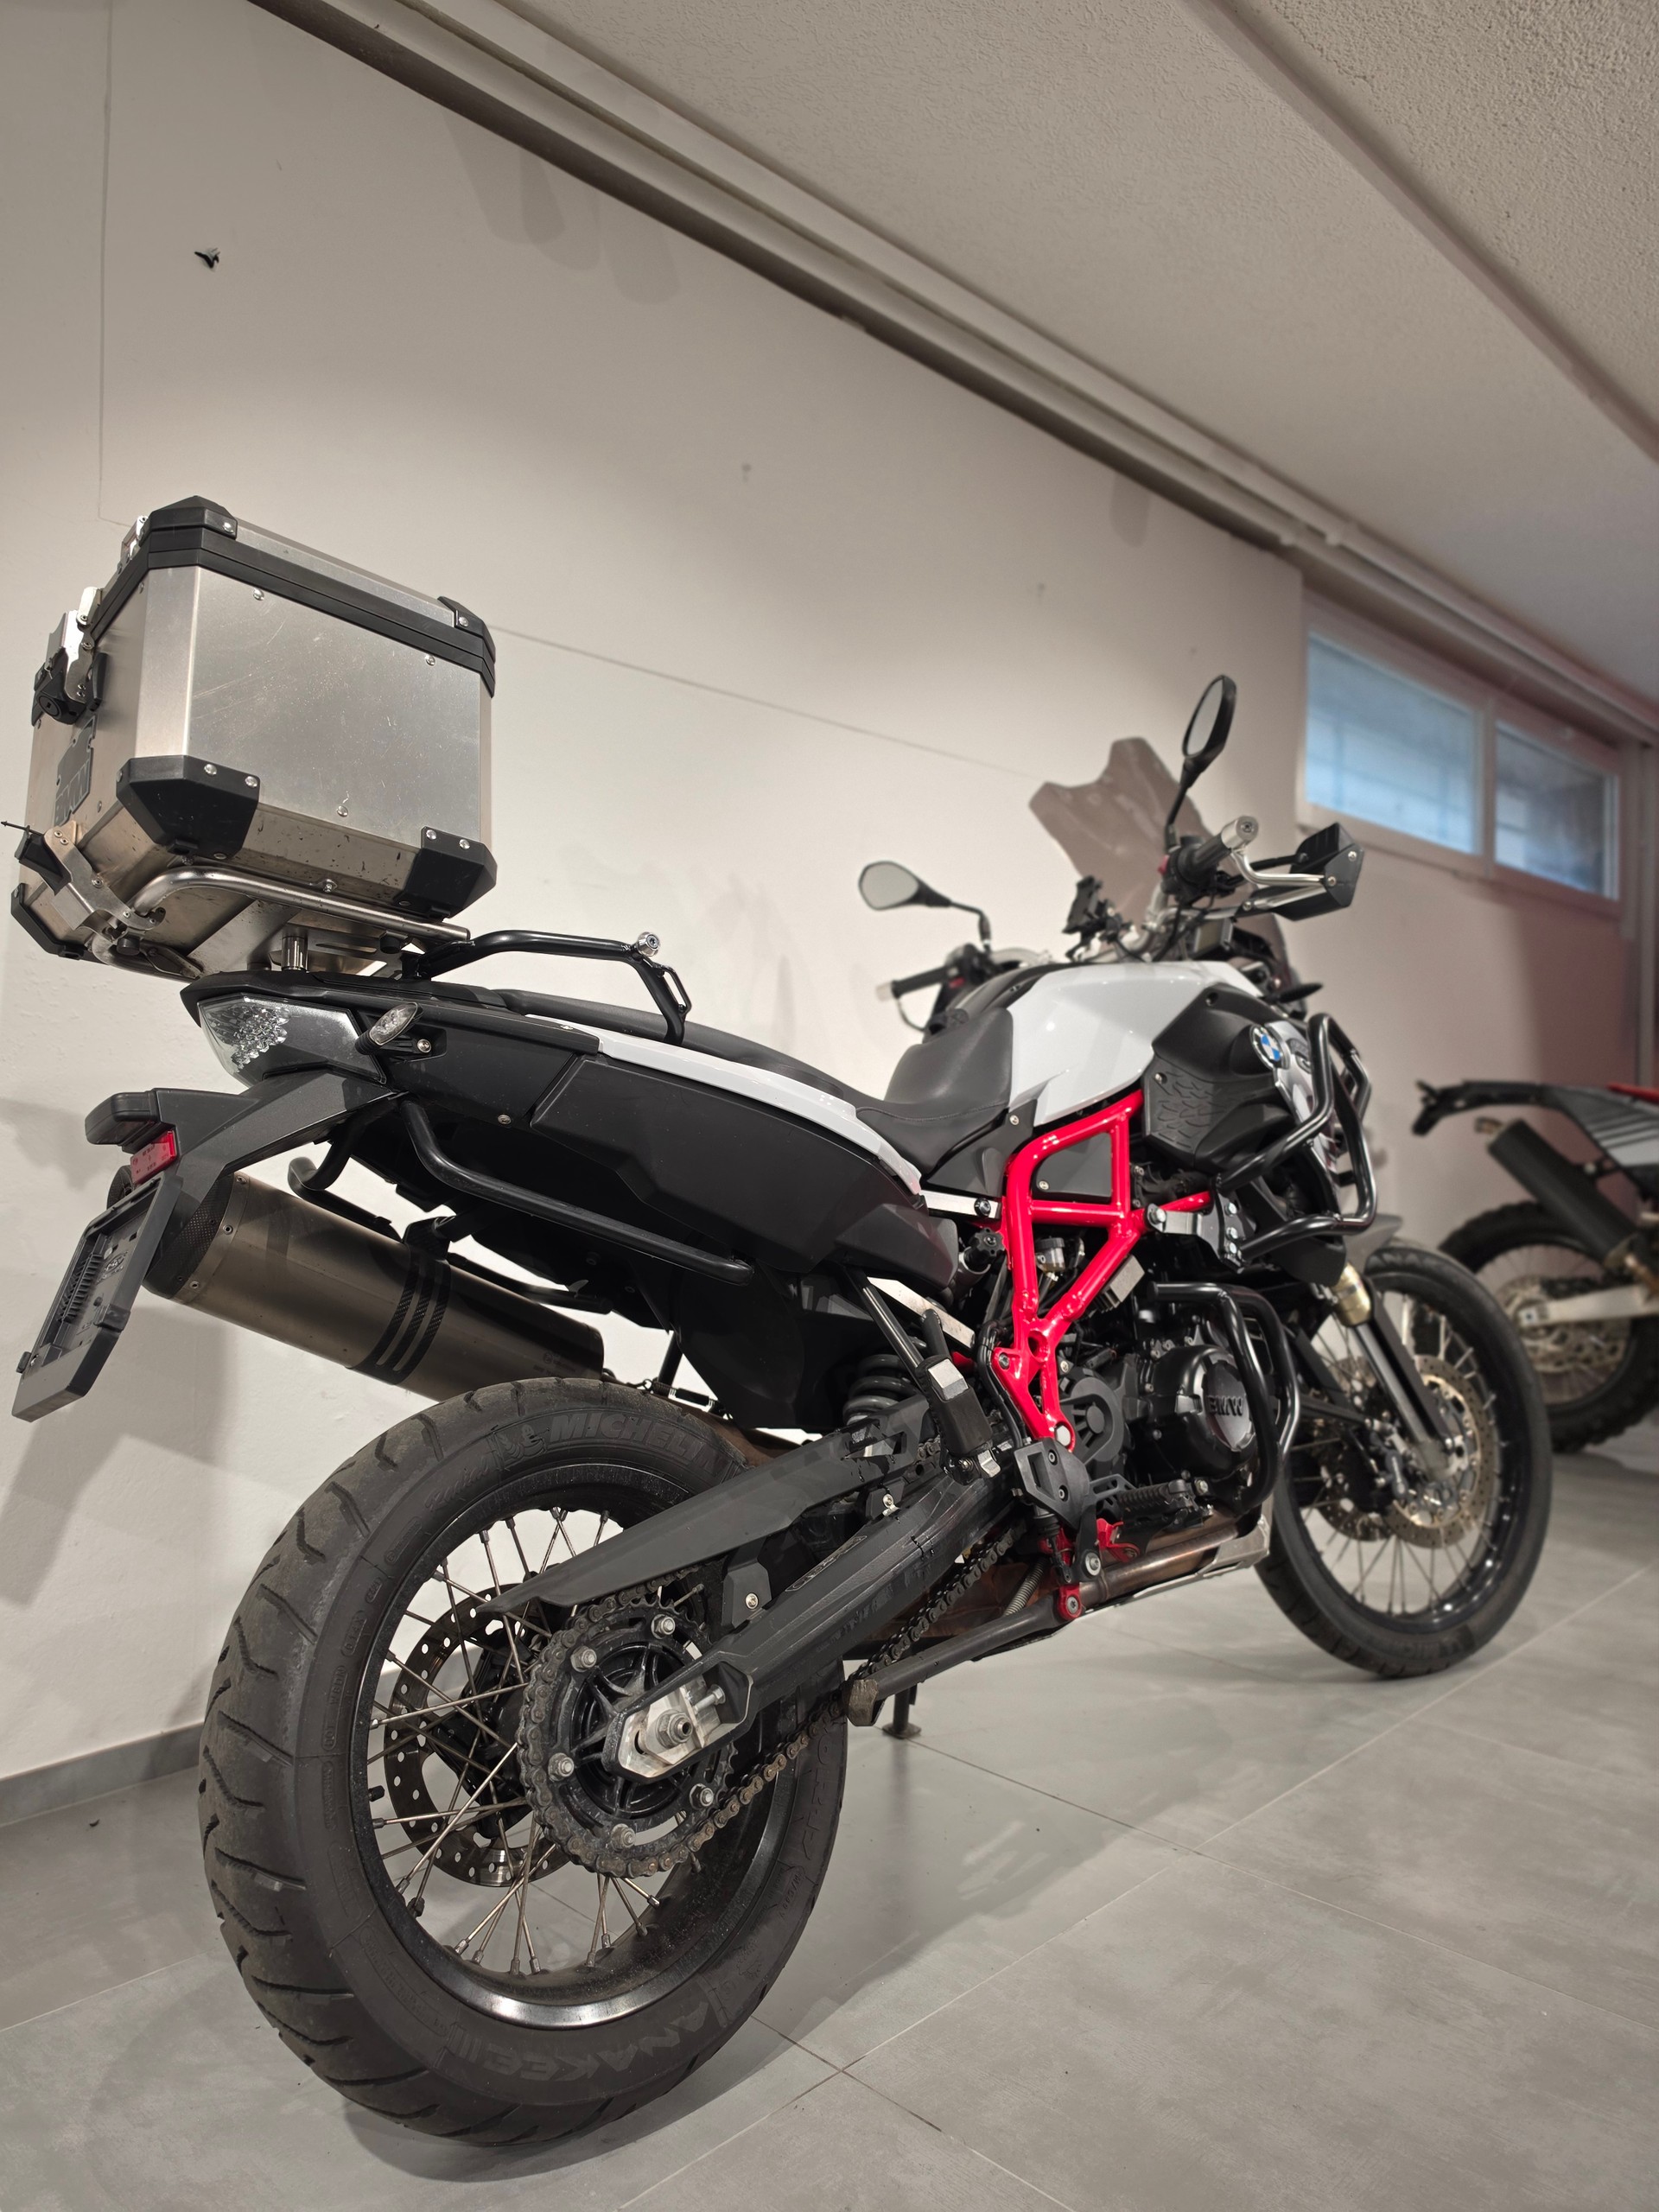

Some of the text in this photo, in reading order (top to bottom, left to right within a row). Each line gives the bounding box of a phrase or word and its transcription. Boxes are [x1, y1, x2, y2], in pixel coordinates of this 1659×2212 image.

[1207, 1395, 1243, 1416] BMW
[550, 1412, 728, 1478] MICHELIN
[483, 2000, 710, 2082] ANAKEE
